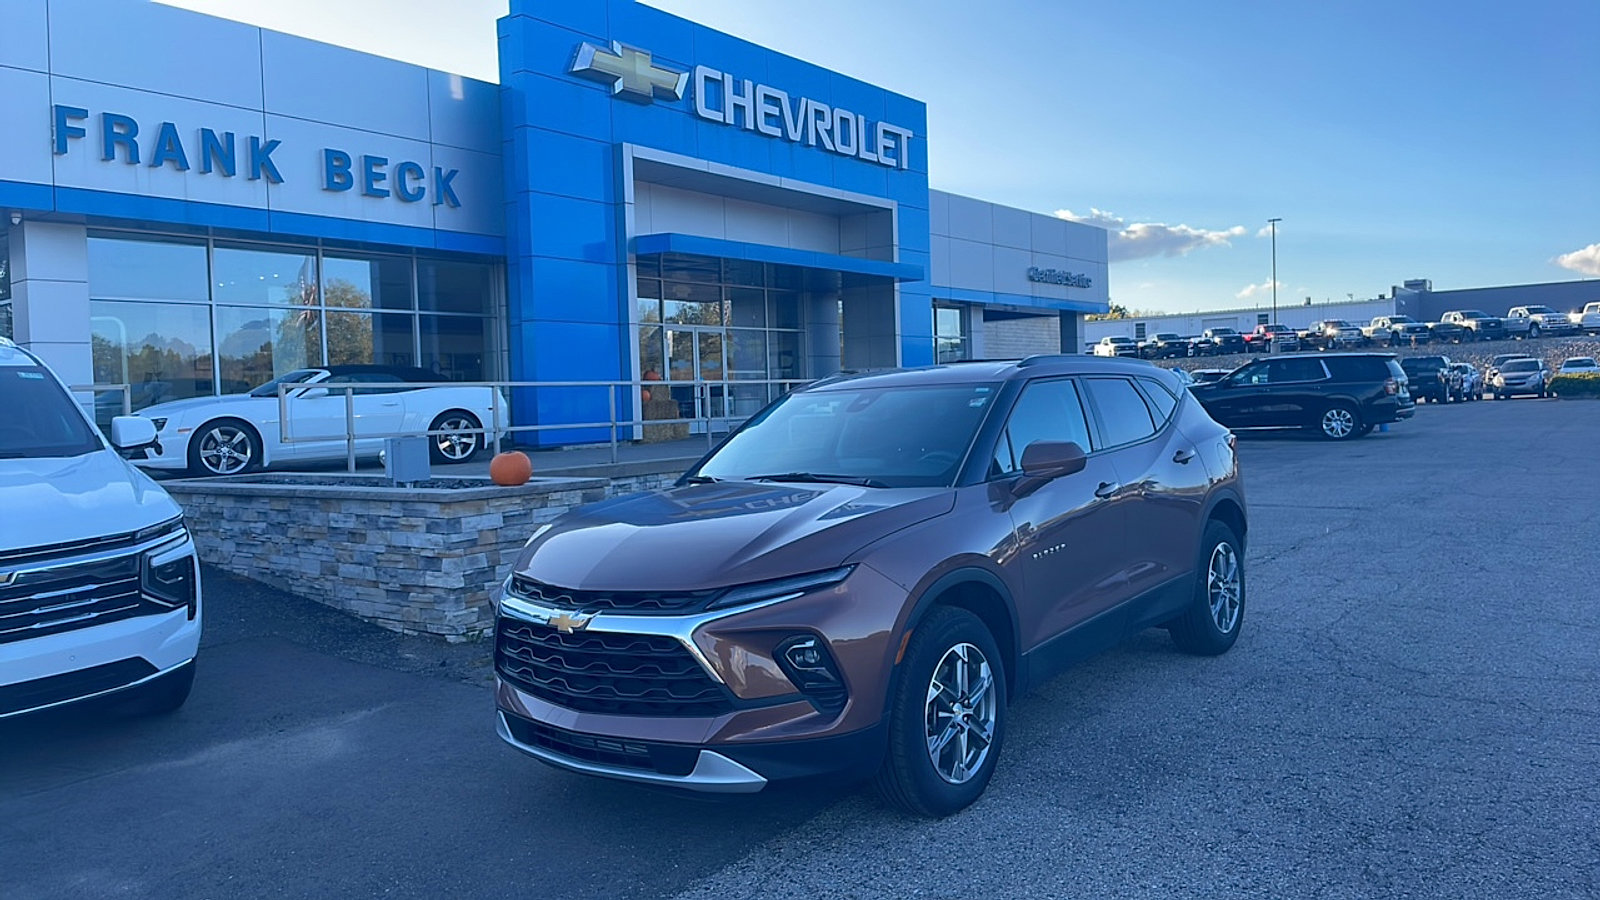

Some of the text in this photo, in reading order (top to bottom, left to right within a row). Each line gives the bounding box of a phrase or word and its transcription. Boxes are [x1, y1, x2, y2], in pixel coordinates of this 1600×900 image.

[53, 104, 462, 207] FRANK BECK
[695, 65, 913, 169] CHEVROLET
